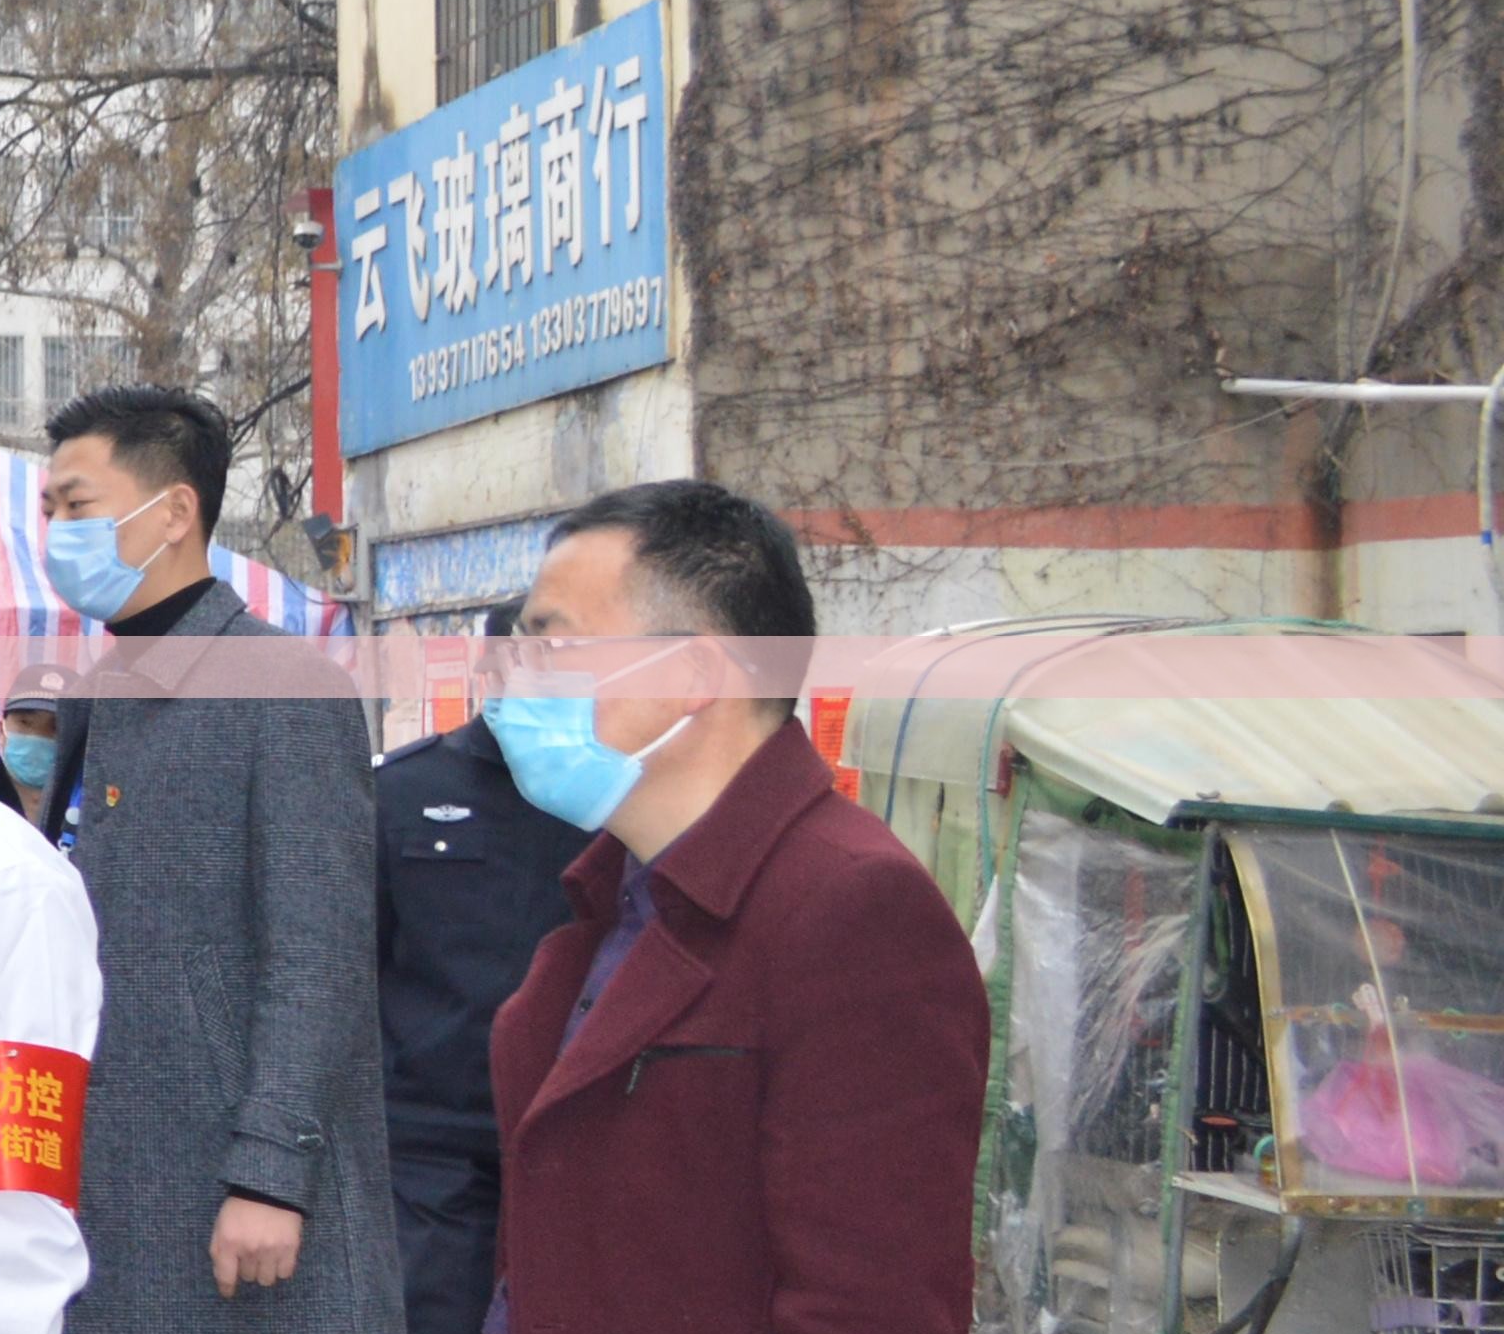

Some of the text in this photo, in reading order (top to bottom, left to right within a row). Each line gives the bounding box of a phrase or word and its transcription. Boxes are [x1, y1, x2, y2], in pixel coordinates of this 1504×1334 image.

[351, 55, 649, 342] 云飞玻璃商行
[408, 277, 663, 403] 13937717654 13303779697
